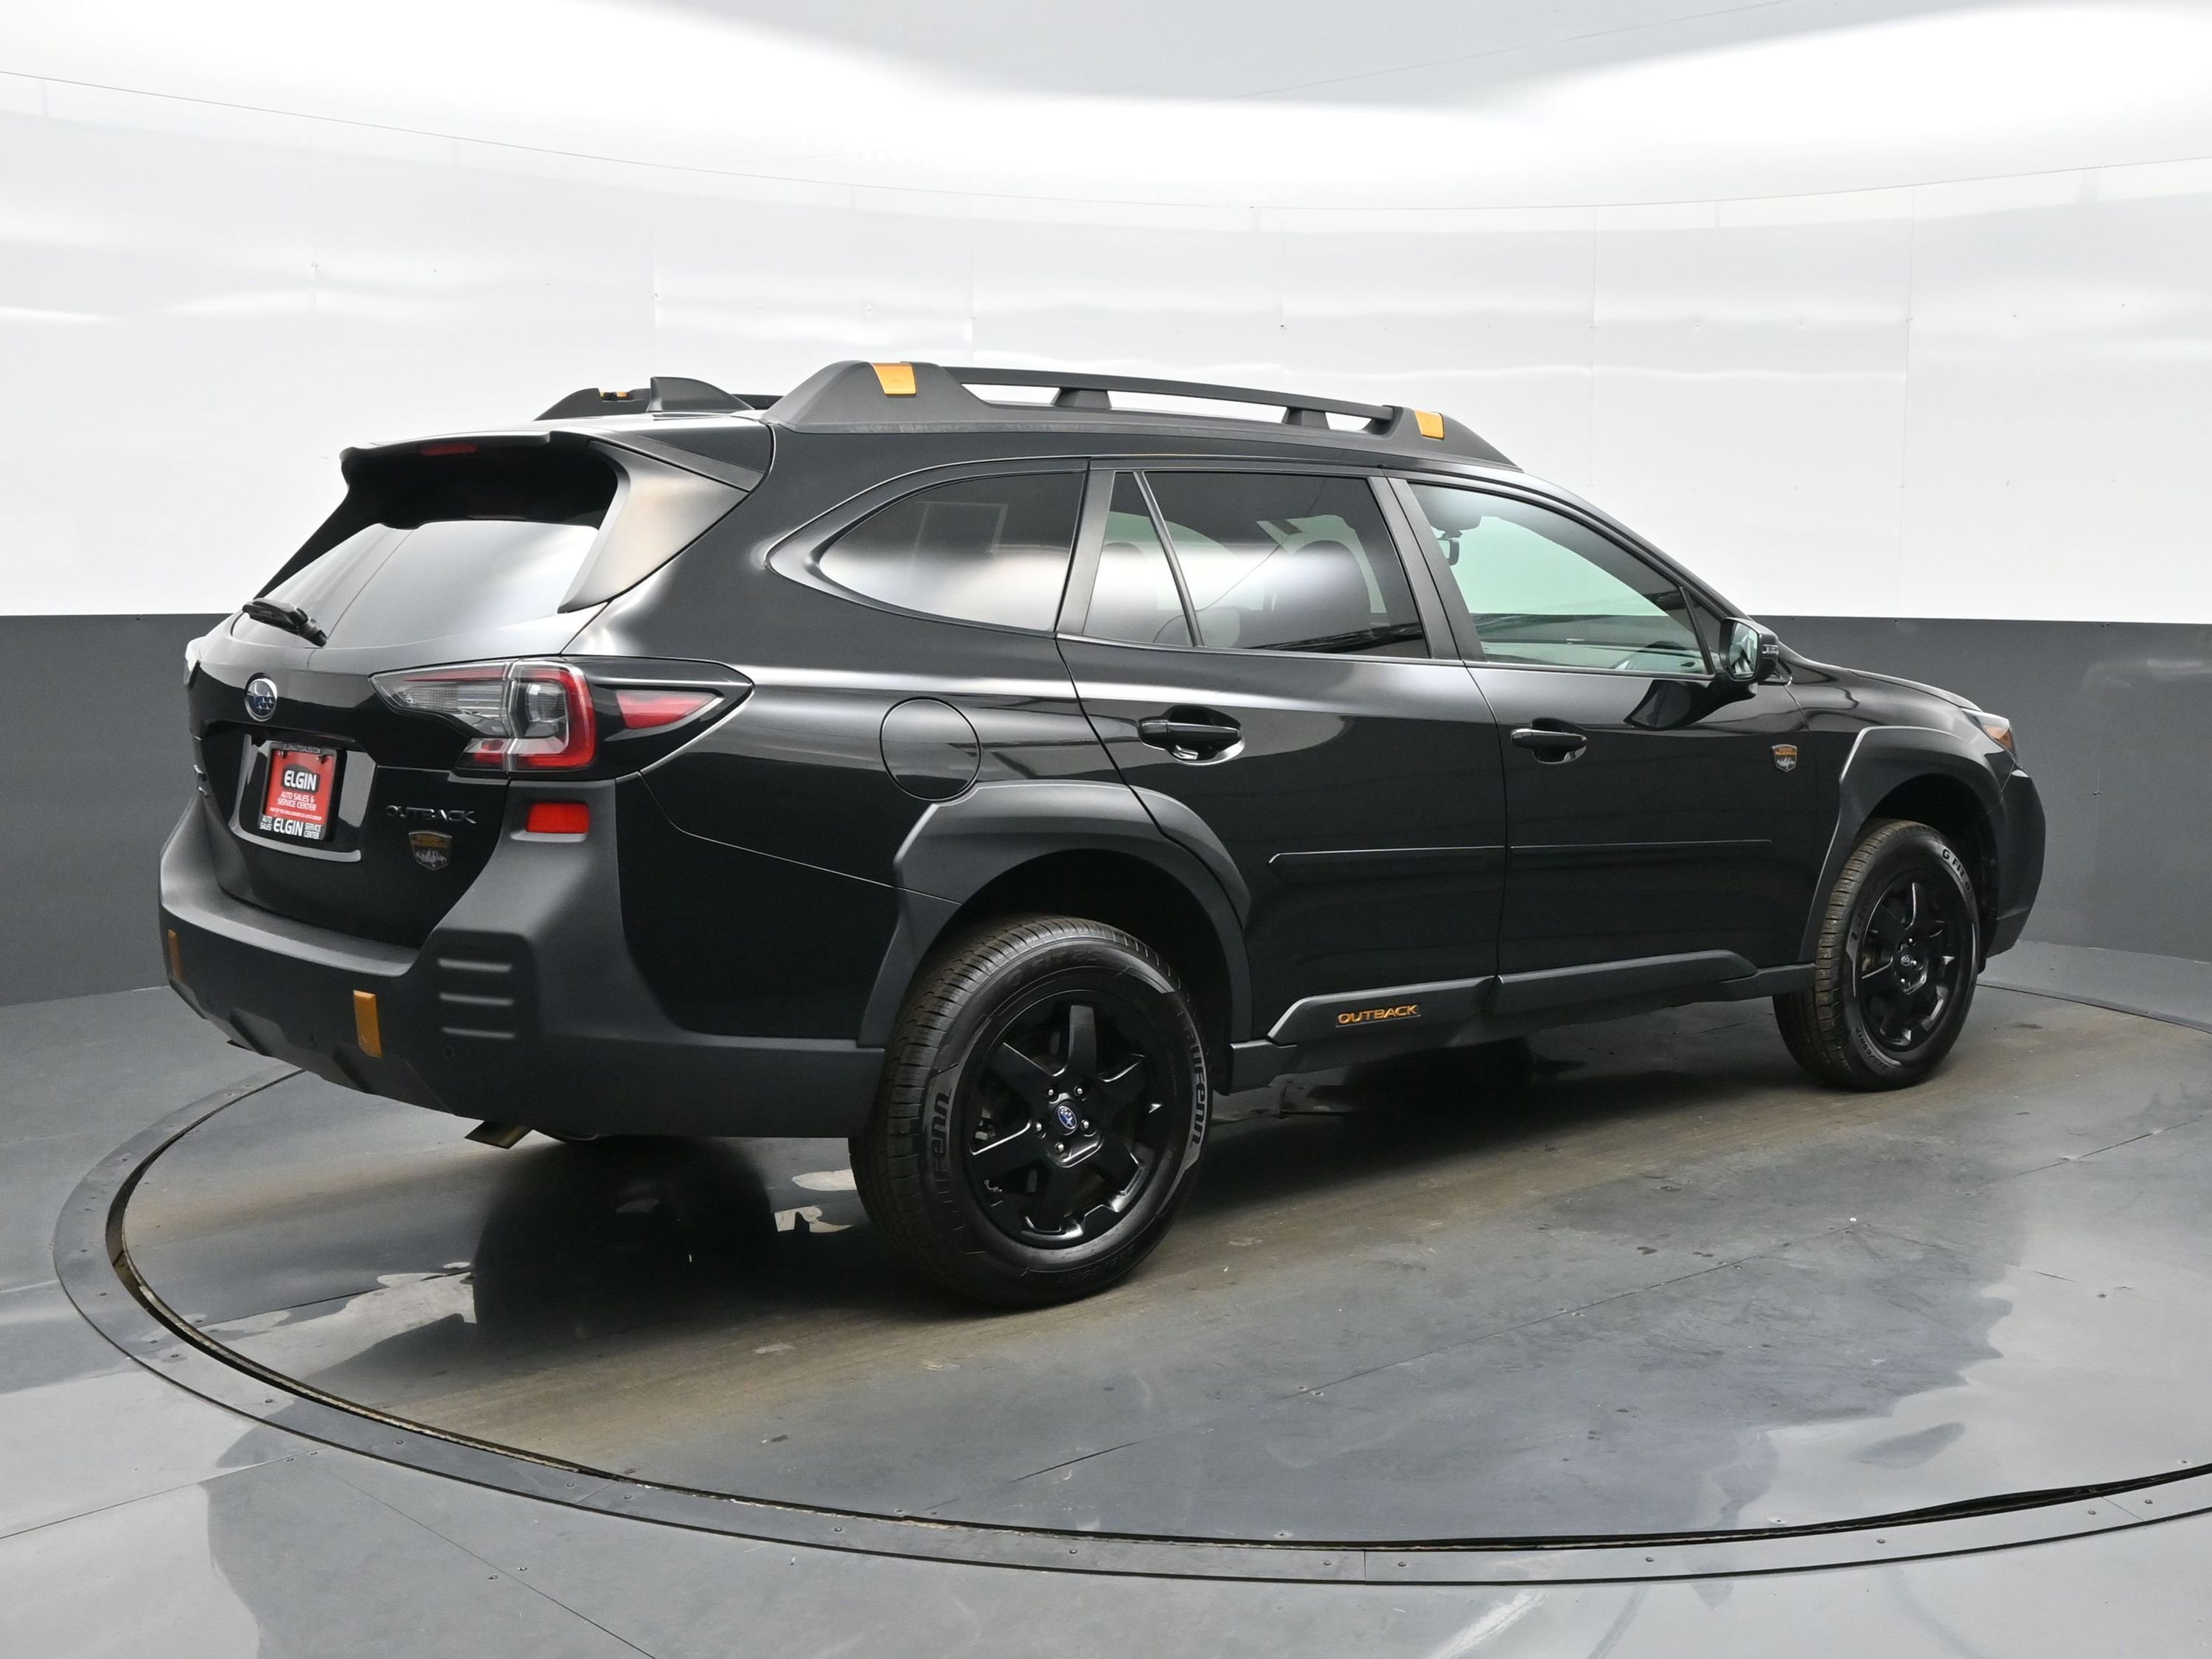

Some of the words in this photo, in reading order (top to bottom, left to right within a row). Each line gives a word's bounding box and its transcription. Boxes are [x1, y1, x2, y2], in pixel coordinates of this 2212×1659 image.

[285, 770, 317, 790] ELGIN
[293, 793, 310, 802] SALES
[277, 798, 296, 807] SERVICE
[296, 801, 316, 812] CENTER
[260, 822, 271, 831] SALES
[274, 818, 304, 837] ELGIN
[305, 823, 321, 832] SERVICE
[304, 831, 319, 839] CENTER
[1338, 1004, 1418, 1024] OUTBACK
